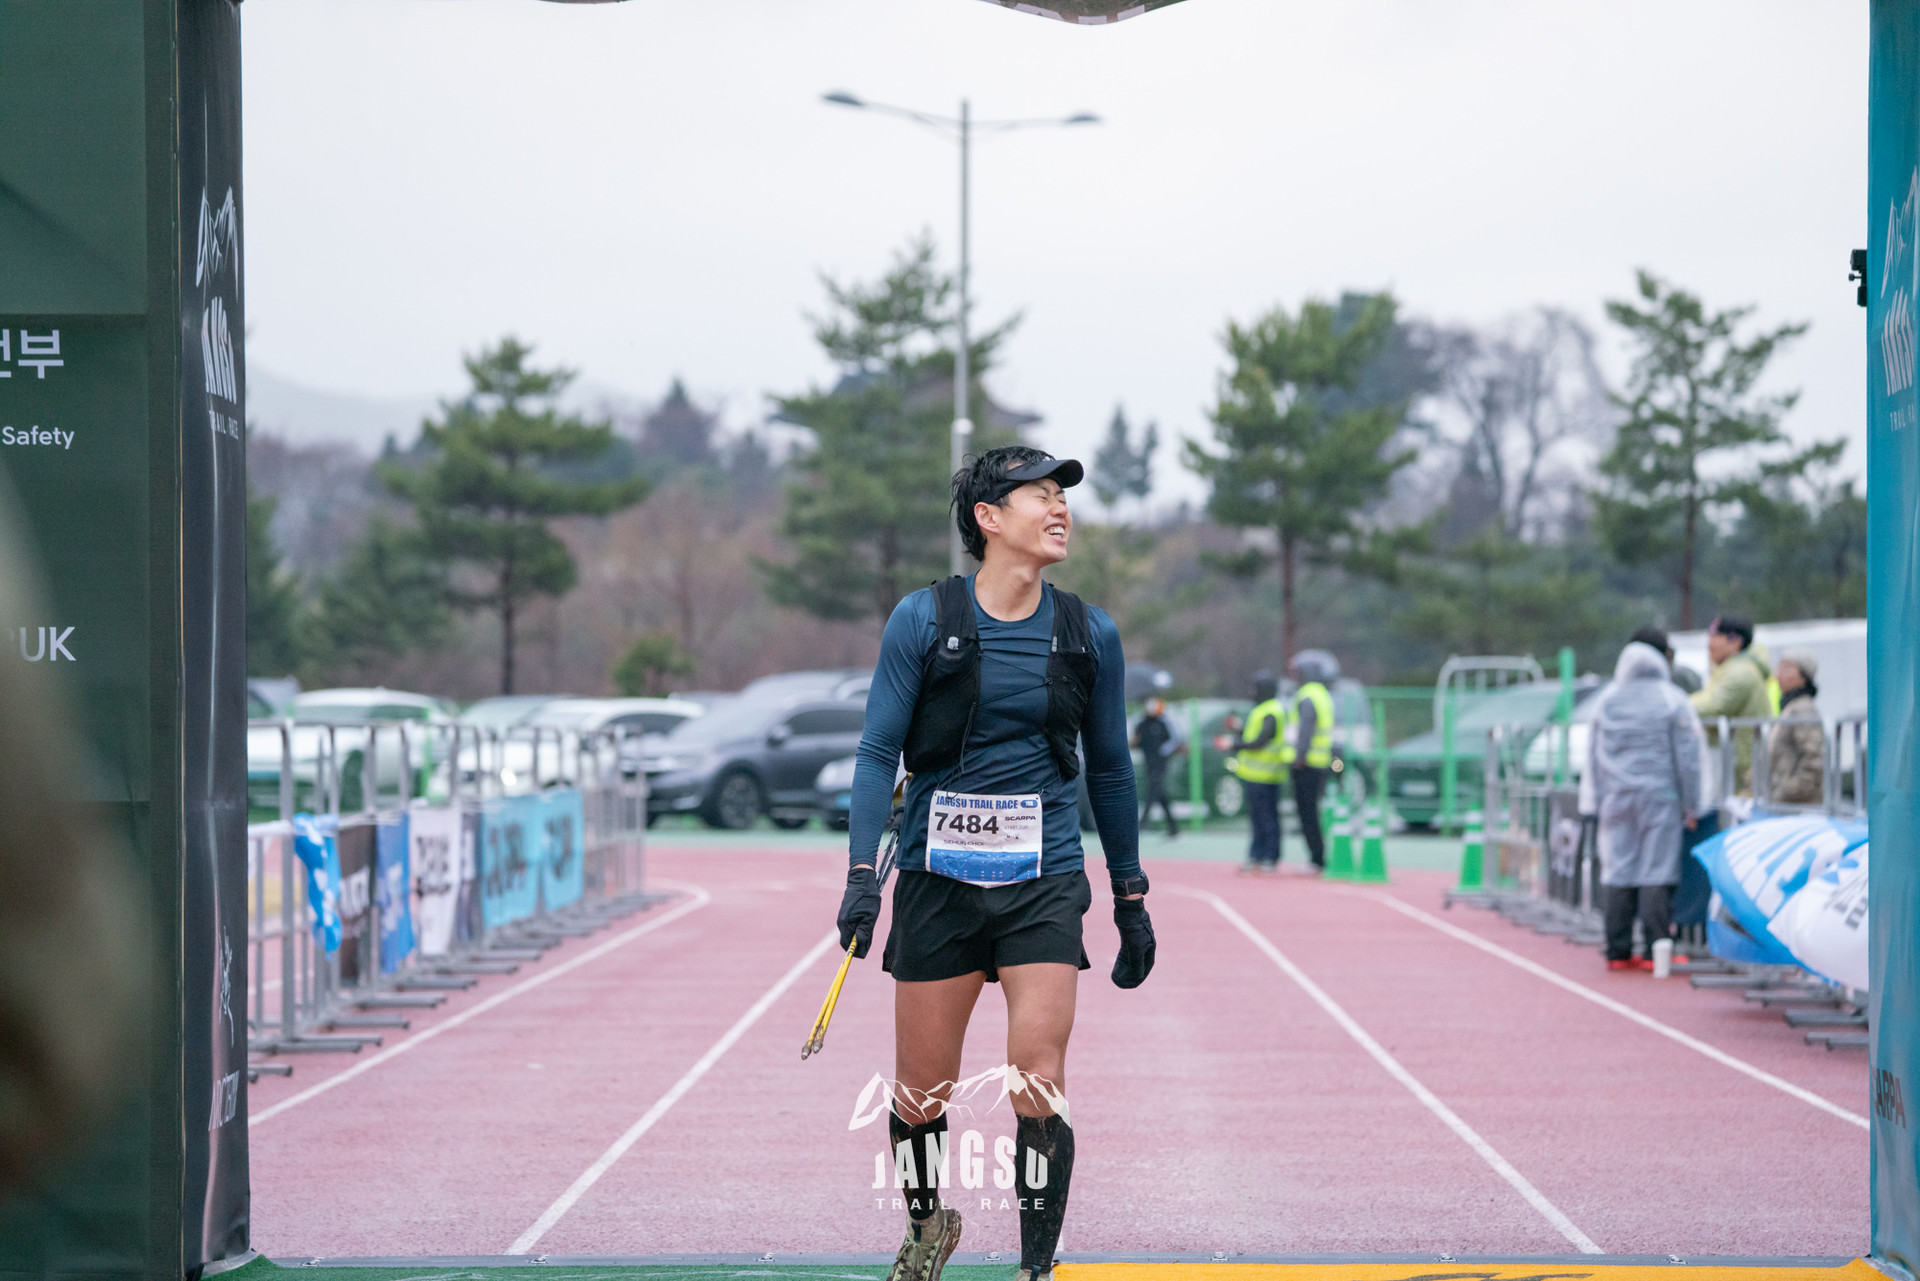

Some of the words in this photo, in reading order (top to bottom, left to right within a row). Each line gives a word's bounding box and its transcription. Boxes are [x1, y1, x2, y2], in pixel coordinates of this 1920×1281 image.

[2, 425, 75, 450] Safety
[936, 796, 967, 808] JANGSU
[969, 799, 993, 809] TRAIL
[996, 799, 1018, 810] RACE
[934, 811, 999, 834] 7484
